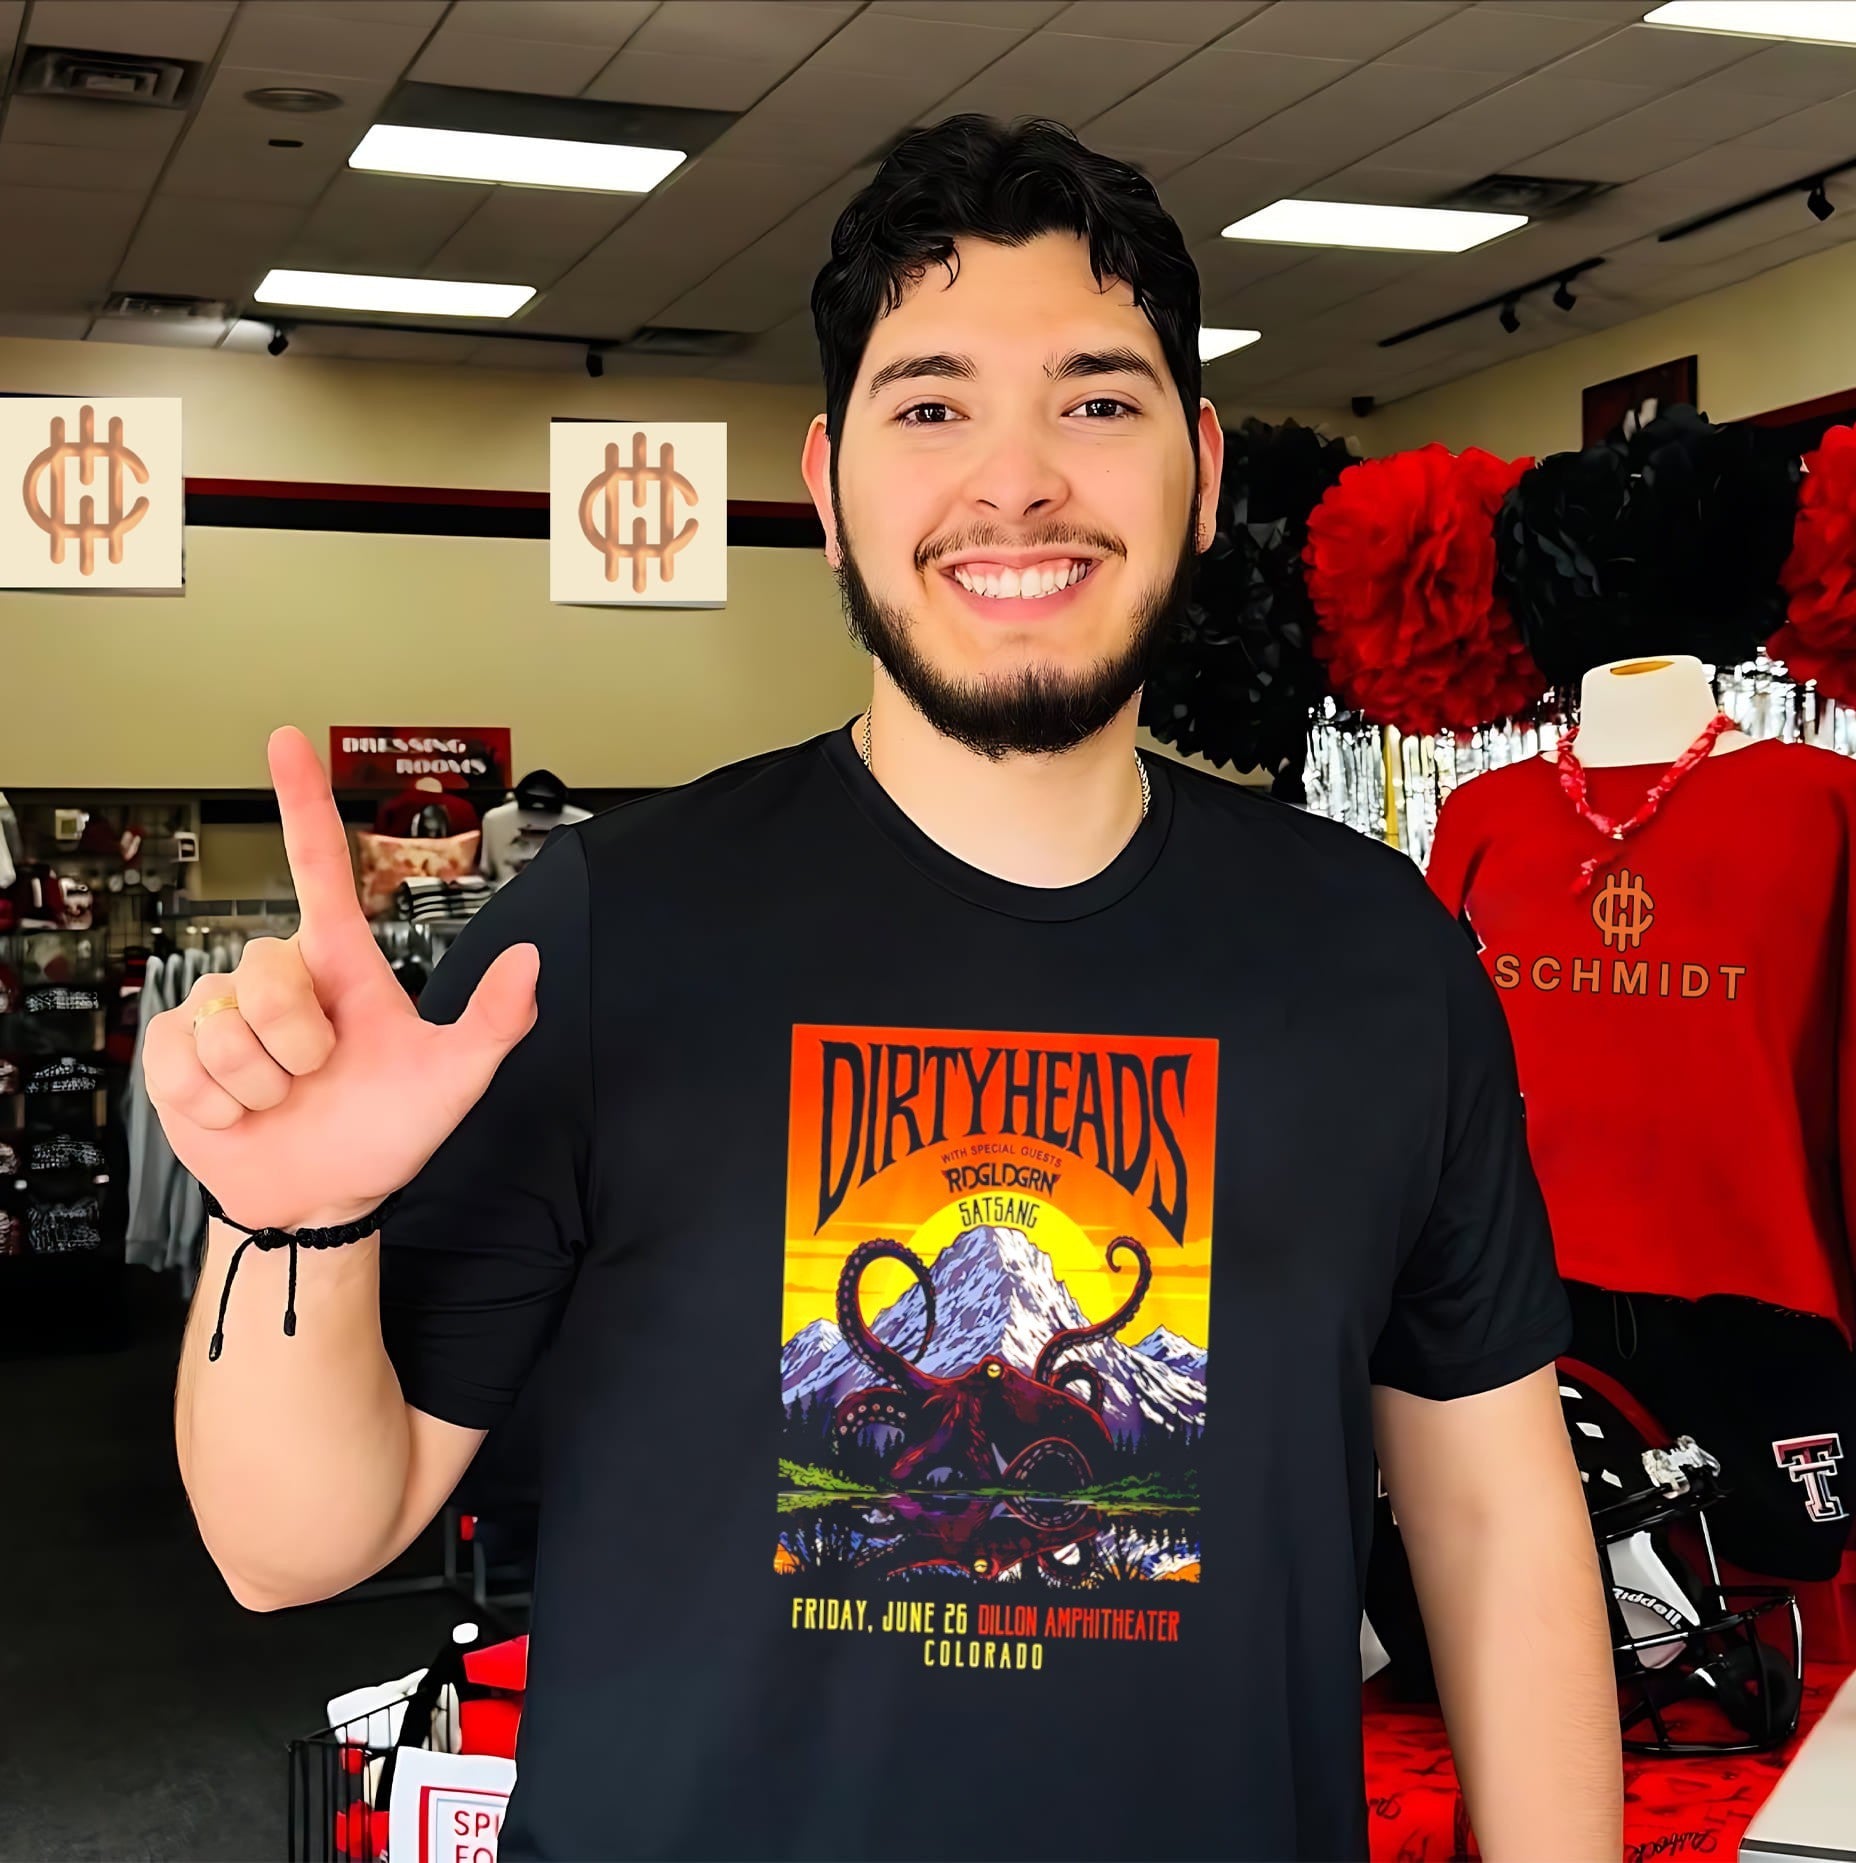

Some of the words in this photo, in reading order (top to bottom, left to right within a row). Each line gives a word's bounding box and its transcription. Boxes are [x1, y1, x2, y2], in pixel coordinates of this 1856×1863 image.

[396, 758, 487, 775] ROOMS
[1494, 954, 1747, 1000] SCHMIDT
[941, 1148, 968, 1164] WITH
[971, 1143, 1016, 1156] SPECIAL
[1020, 1146, 1063, 1168] GUESTS
[958, 1196, 1041, 1229] SATSANG
[791, 1597, 873, 1634] FRIDAY,
[882, 1601, 935, 1634] JUNE
[943, 1603, 968, 1635] 26
[977, 1604, 1038, 1637] DILLON
[1044, 1606, 1181, 1642] AMPHITHEATER
[923, 1639, 1043, 1670] COLORADO
